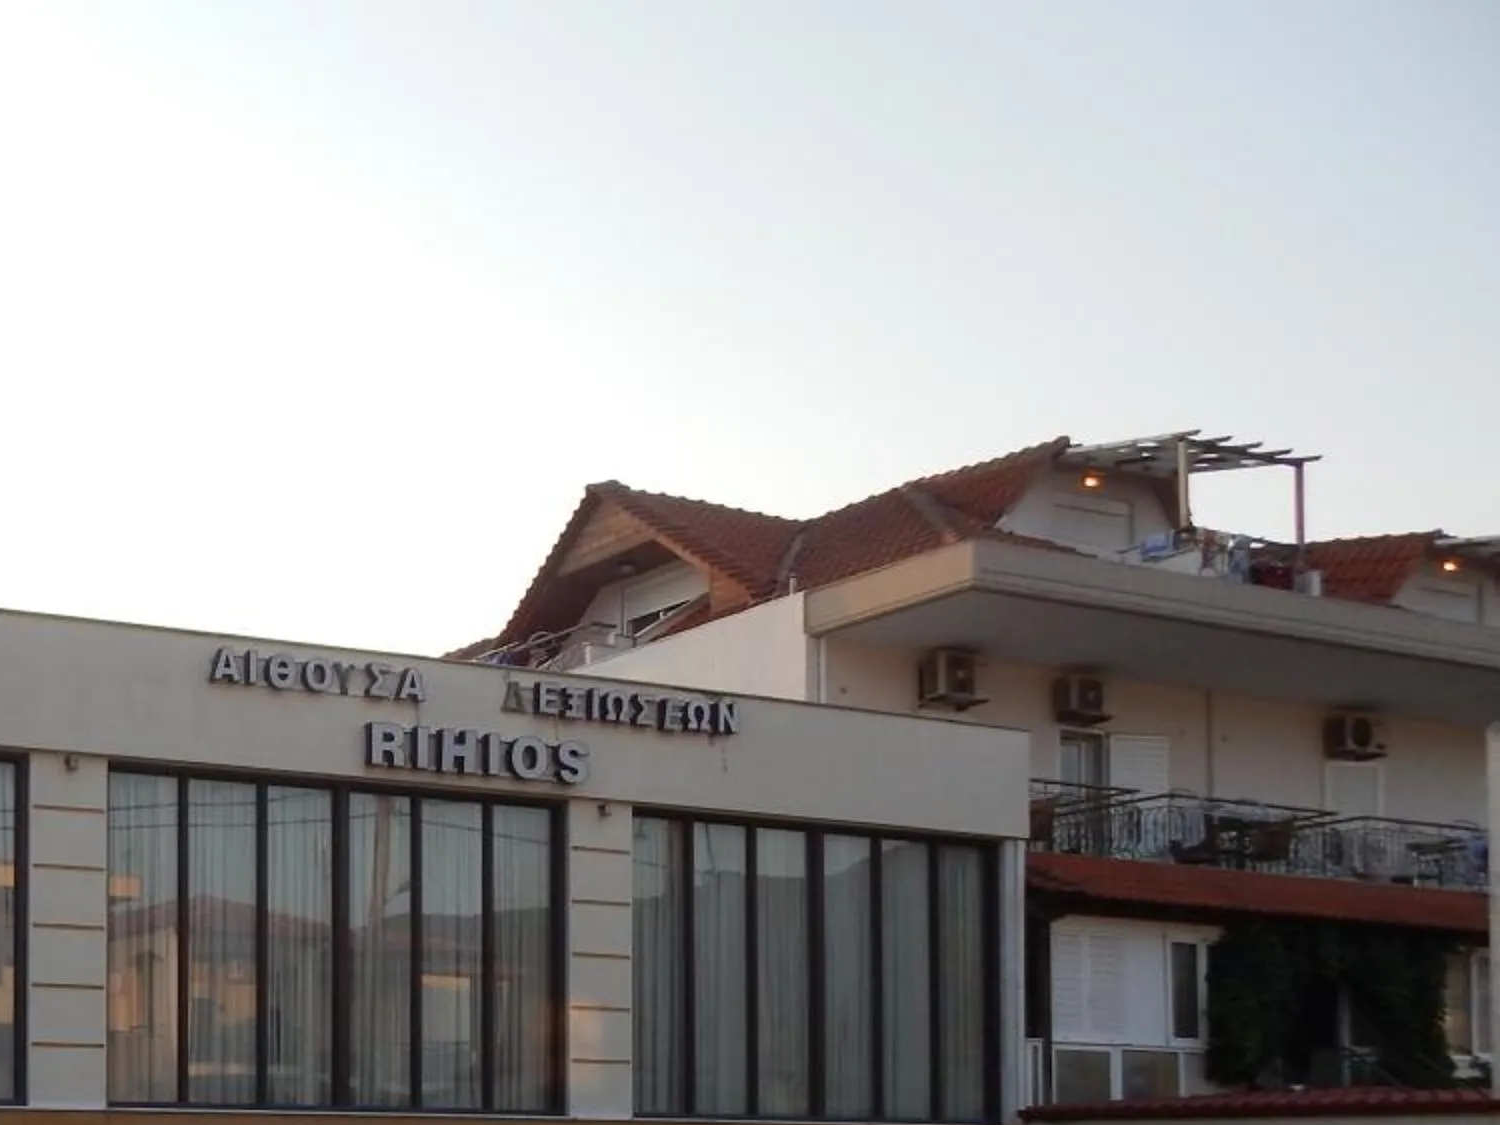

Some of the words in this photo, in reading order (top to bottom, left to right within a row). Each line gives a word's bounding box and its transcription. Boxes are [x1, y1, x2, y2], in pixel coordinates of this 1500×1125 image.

[209, 645, 425, 702] ΑΙΘΟΥΣΑ
[502, 681, 739, 735] ΔΕΞΙΩΣΕΩΝ
[364, 721, 592, 785] RIHIOS
